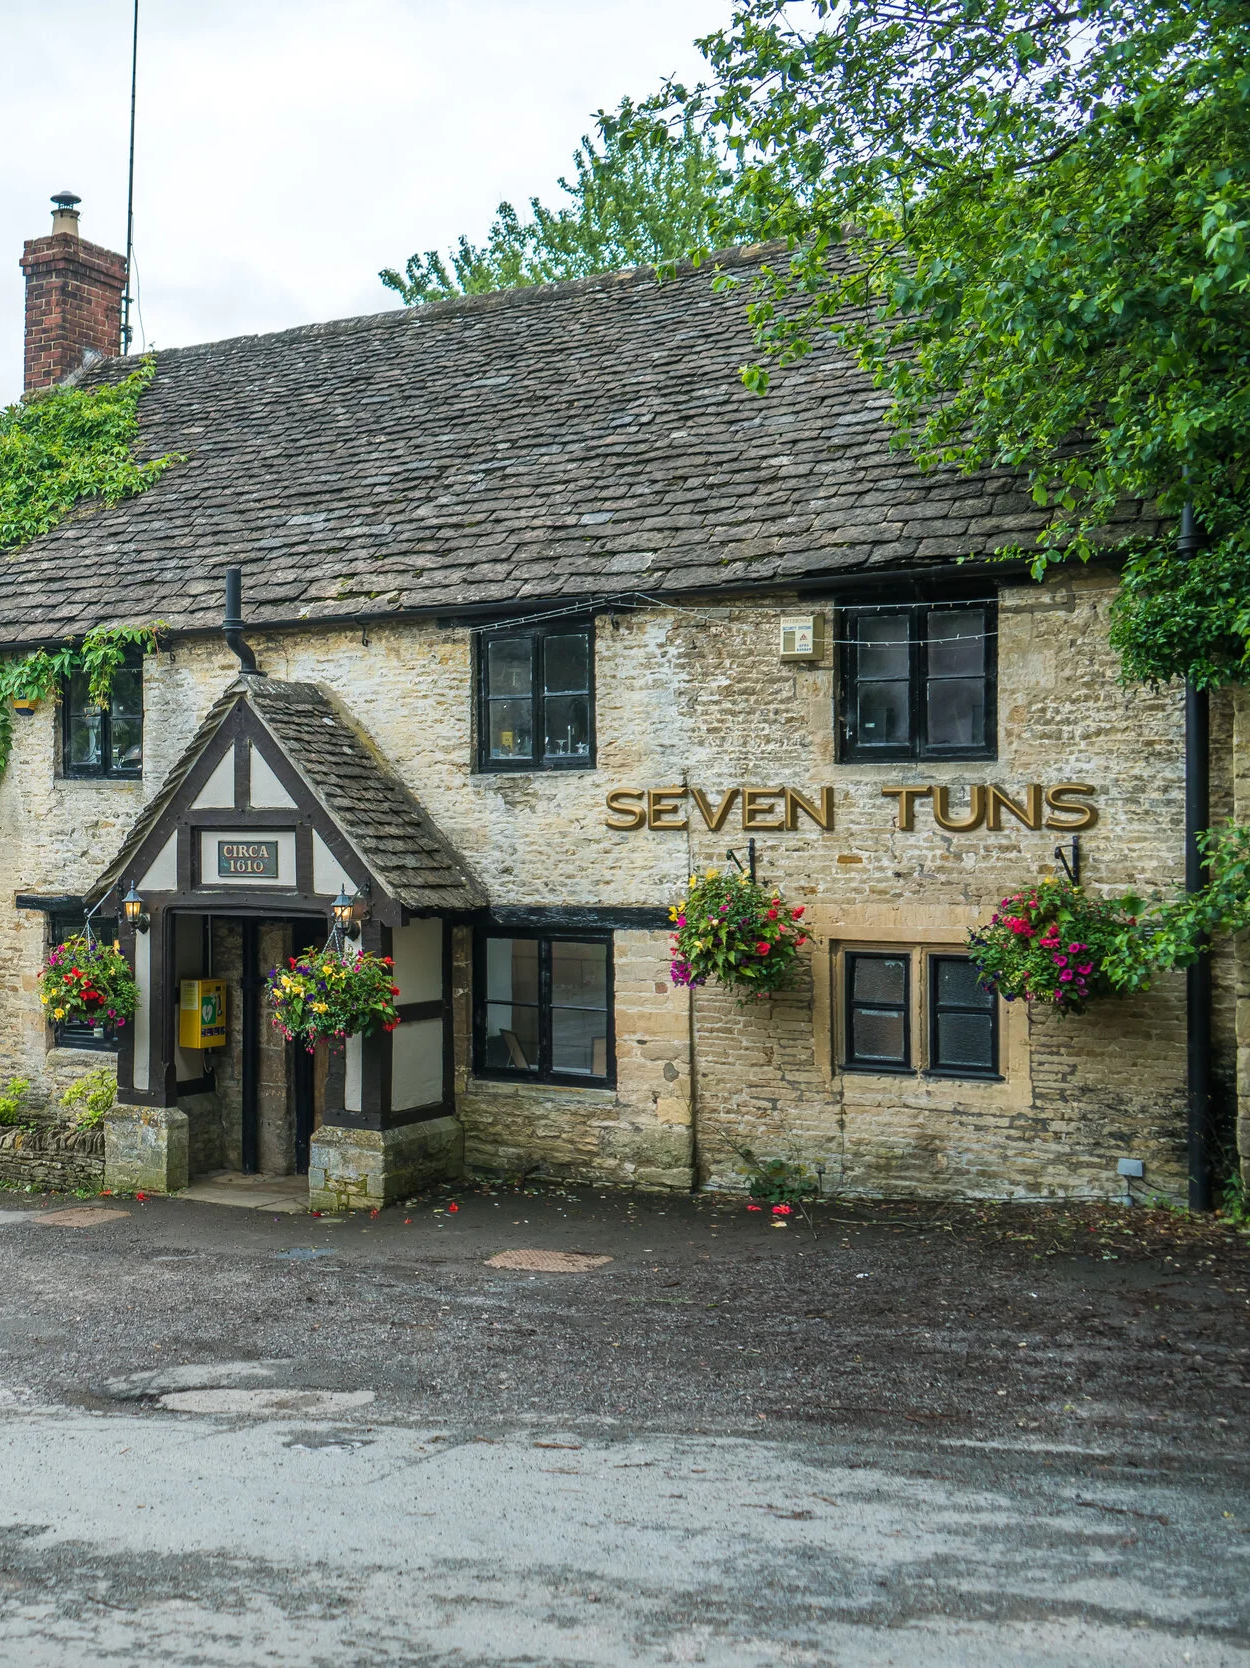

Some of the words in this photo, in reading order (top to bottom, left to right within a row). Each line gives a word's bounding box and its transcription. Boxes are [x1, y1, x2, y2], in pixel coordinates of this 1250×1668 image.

[605, 785, 835, 832] SEVEN
[881, 782, 1099, 833] TUNS
[223, 845, 269, 858] CIRCA
[229, 860, 264, 872] 1610
